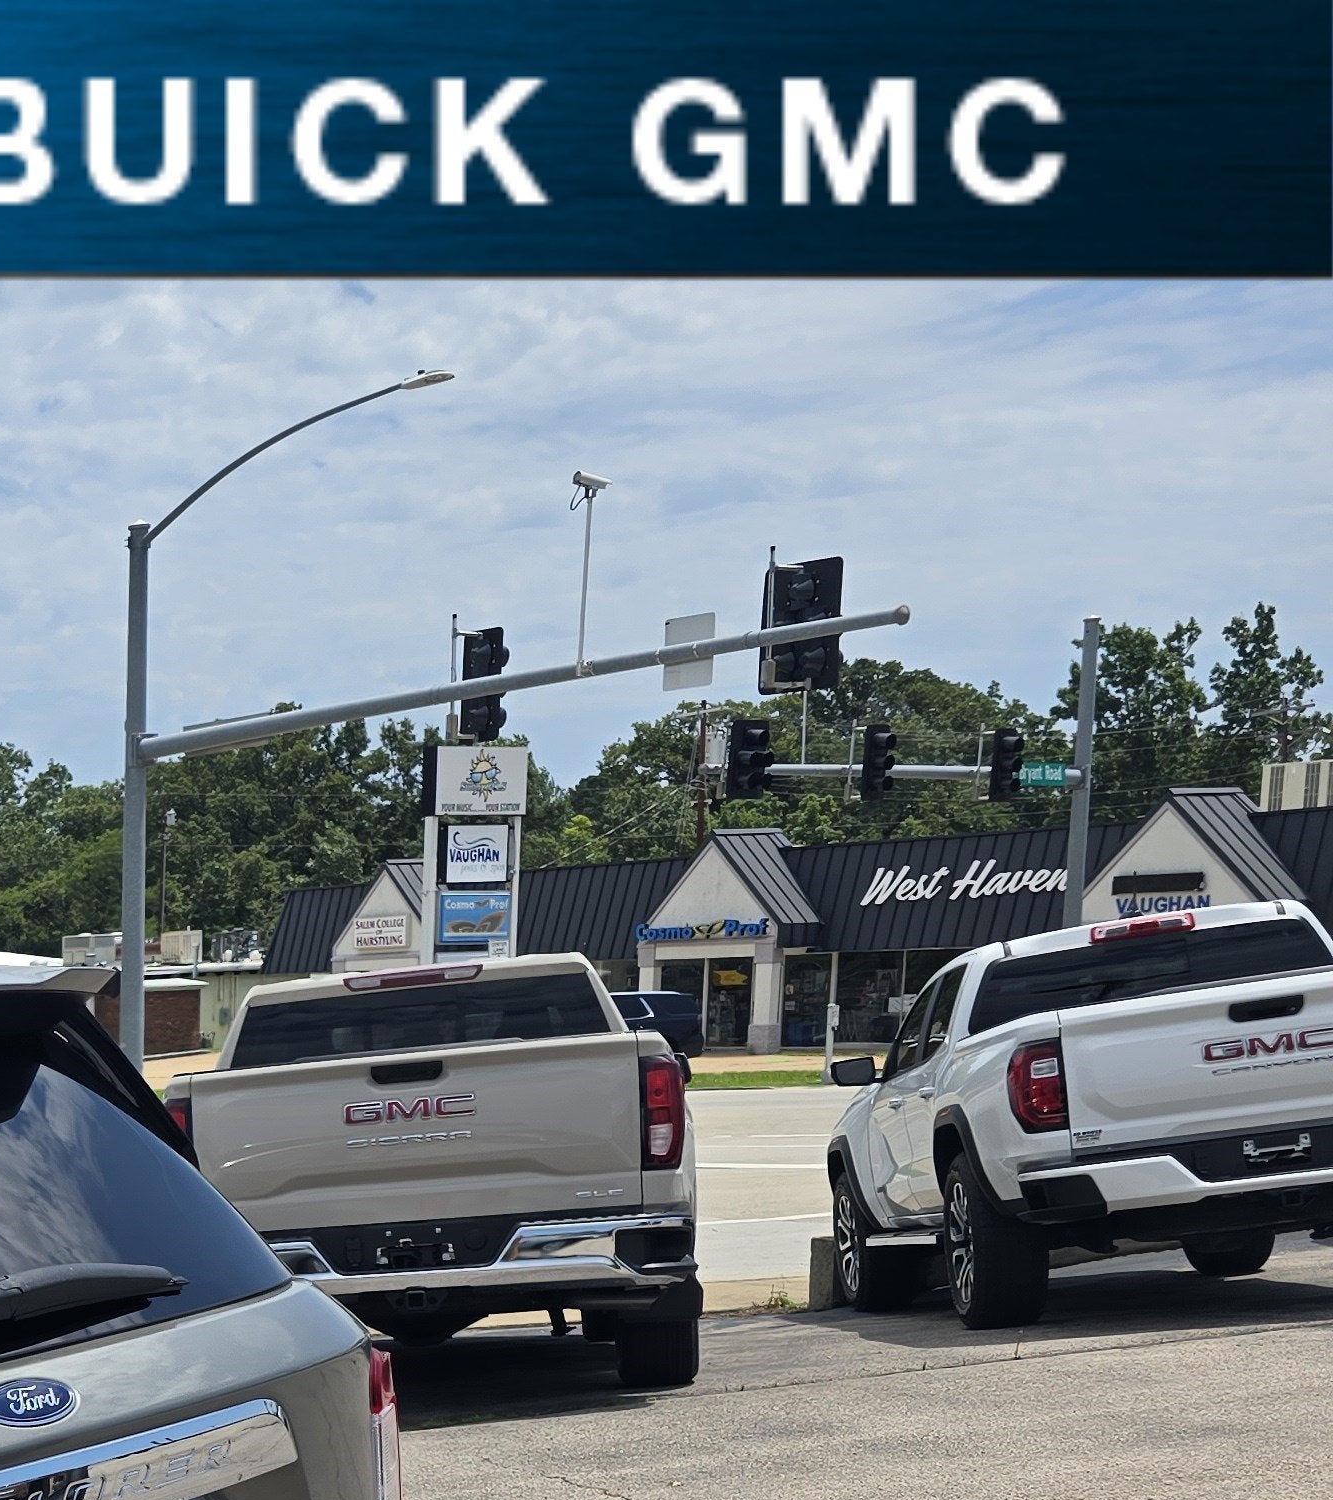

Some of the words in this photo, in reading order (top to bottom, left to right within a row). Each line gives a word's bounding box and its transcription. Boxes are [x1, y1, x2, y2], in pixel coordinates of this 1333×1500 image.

[449, 848, 500, 863] VAUGHAN
[860, 865, 949, 907] West
[949, 859, 1069, 900] Haven
[444, 899, 475, 911] Cosmo
[490, 898, 509, 911] Prof
[1115, 894, 1211, 914] VAUGHAN
[376, 918, 405, 929] COLLEGE
[635, 923, 694, 943] Cosmo
[724, 917, 771, 938] Prof
[1203, 1025, 1333, 1064] GMC
[343, 1092, 477, 1125] GMC
[346, 1130, 473, 1148] SIERRA
[5, 1384, 61, 1415] Ford
